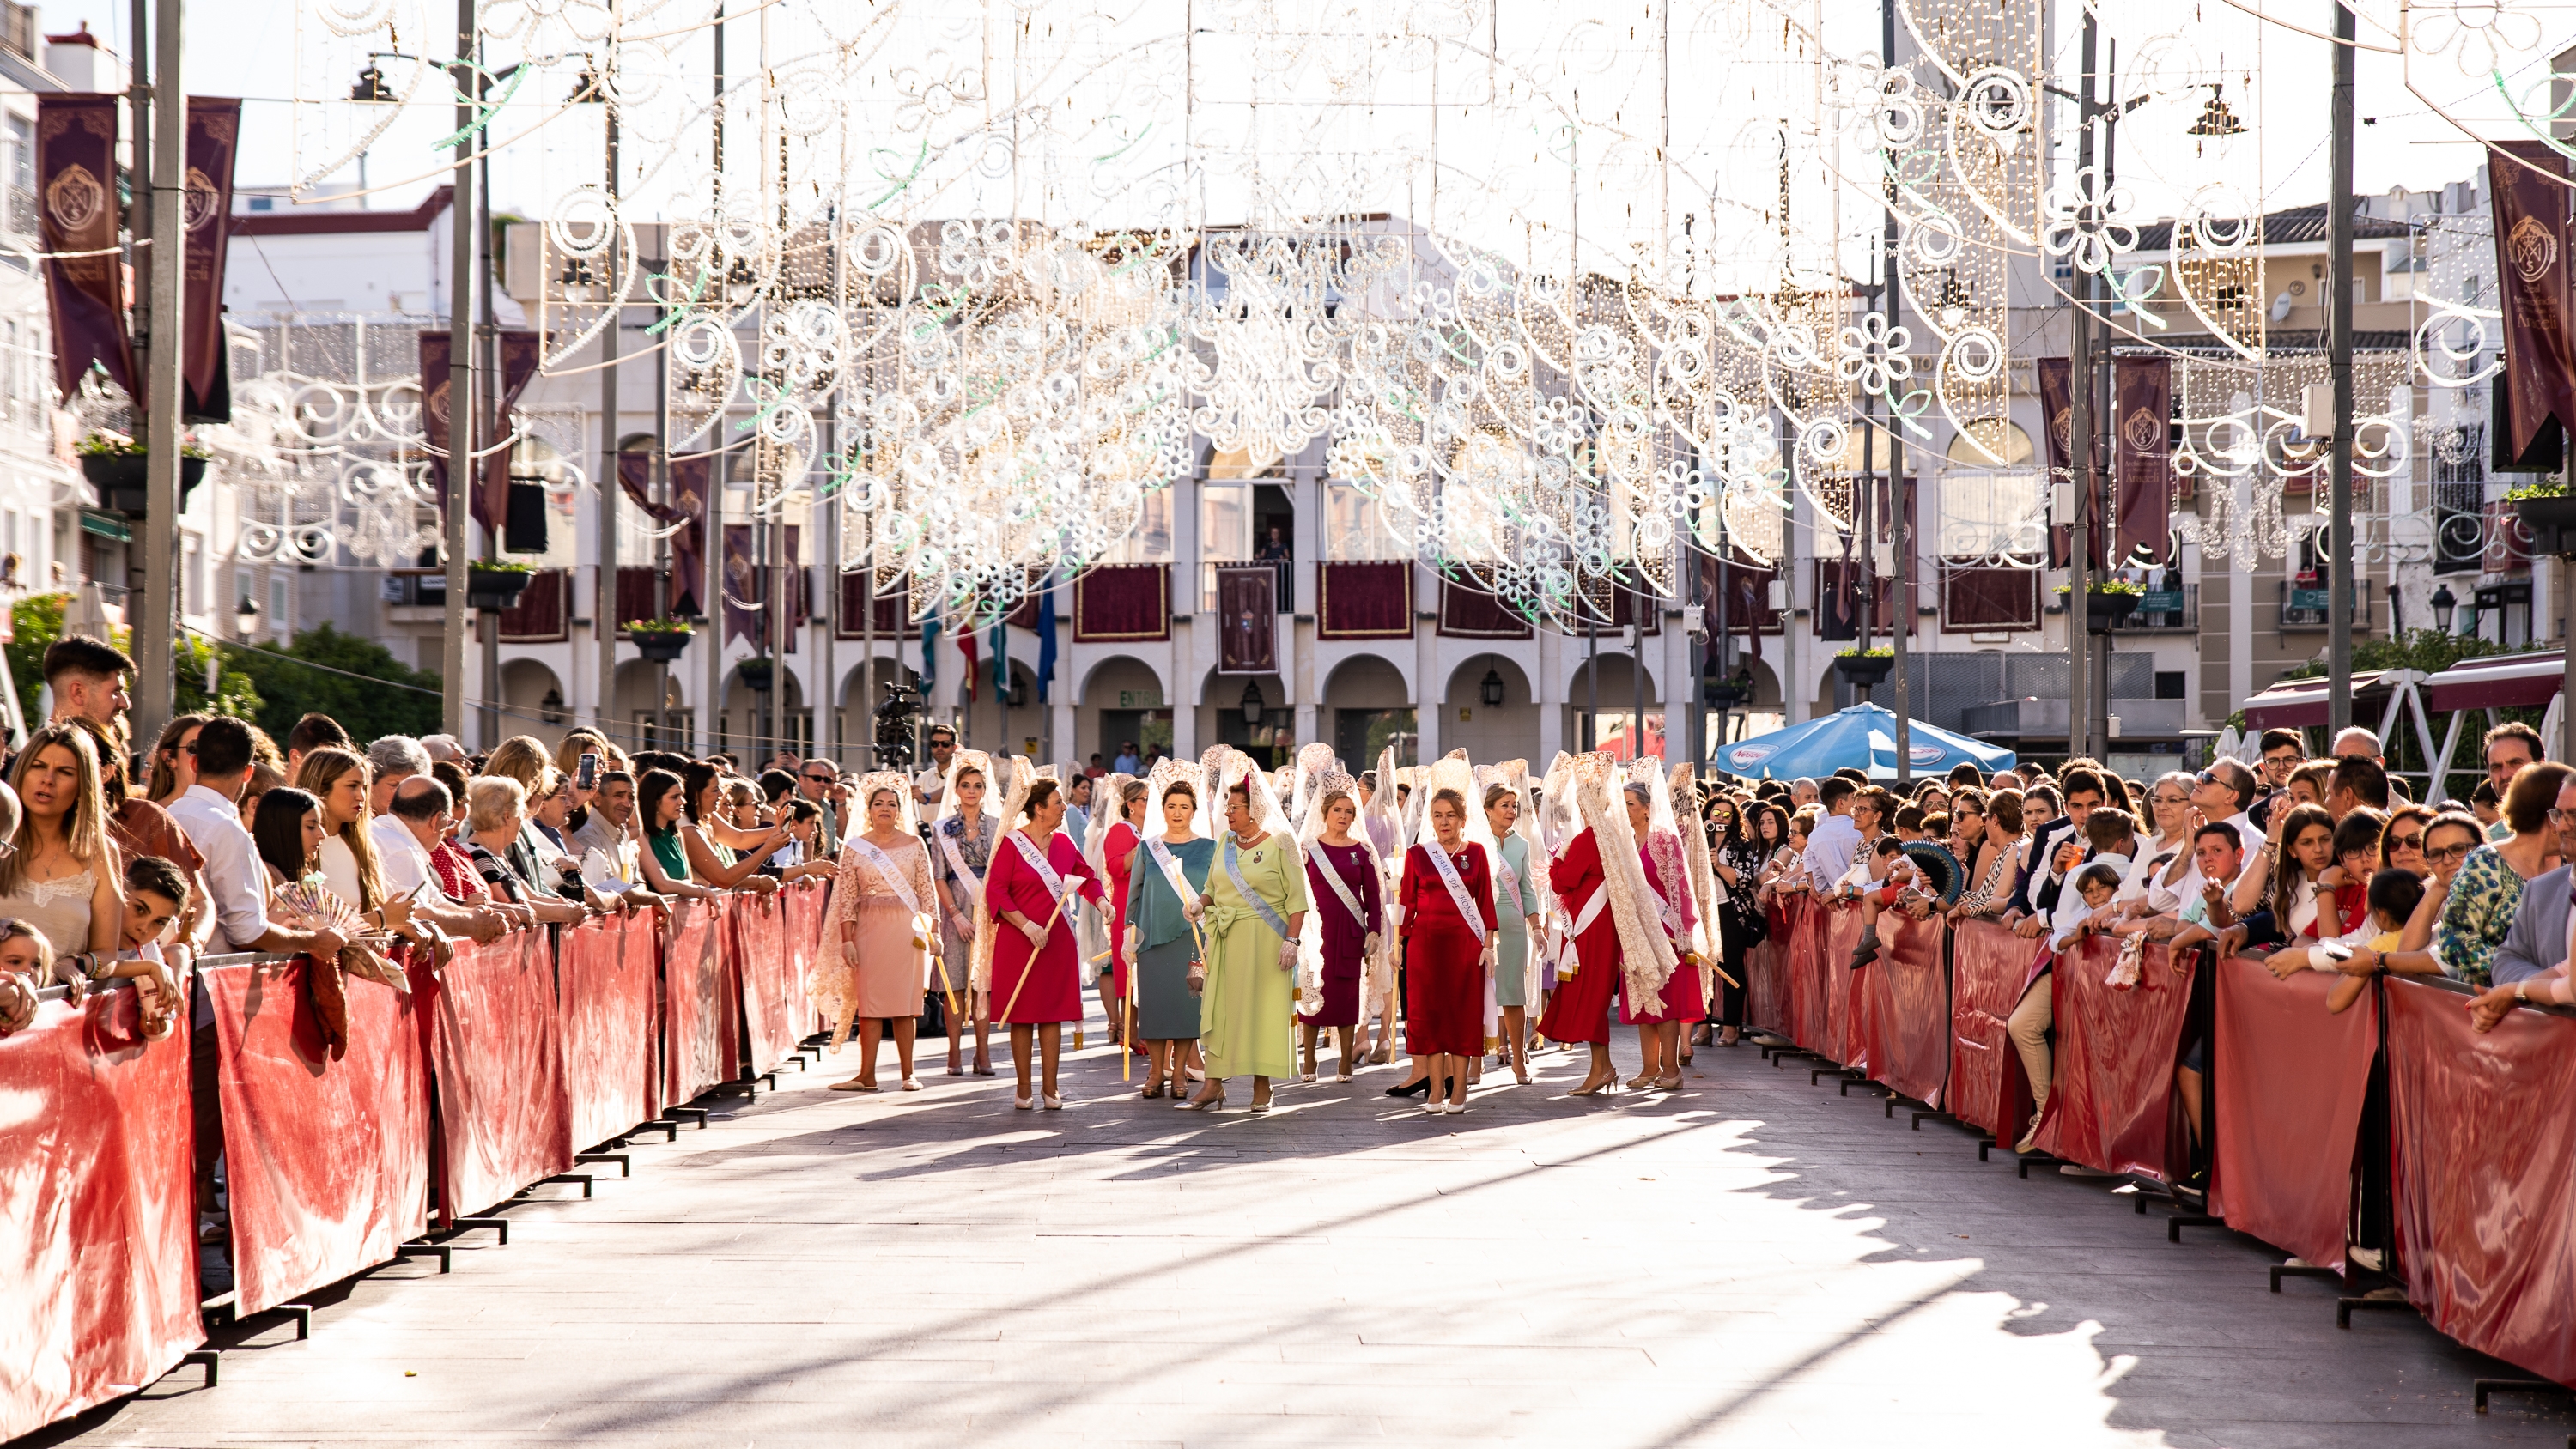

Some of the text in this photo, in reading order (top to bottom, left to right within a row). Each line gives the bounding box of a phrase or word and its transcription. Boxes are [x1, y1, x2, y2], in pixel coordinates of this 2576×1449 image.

[1040, 864, 1052, 876] DE
[1434, 854, 1477, 924] DAMA DE HONOR
